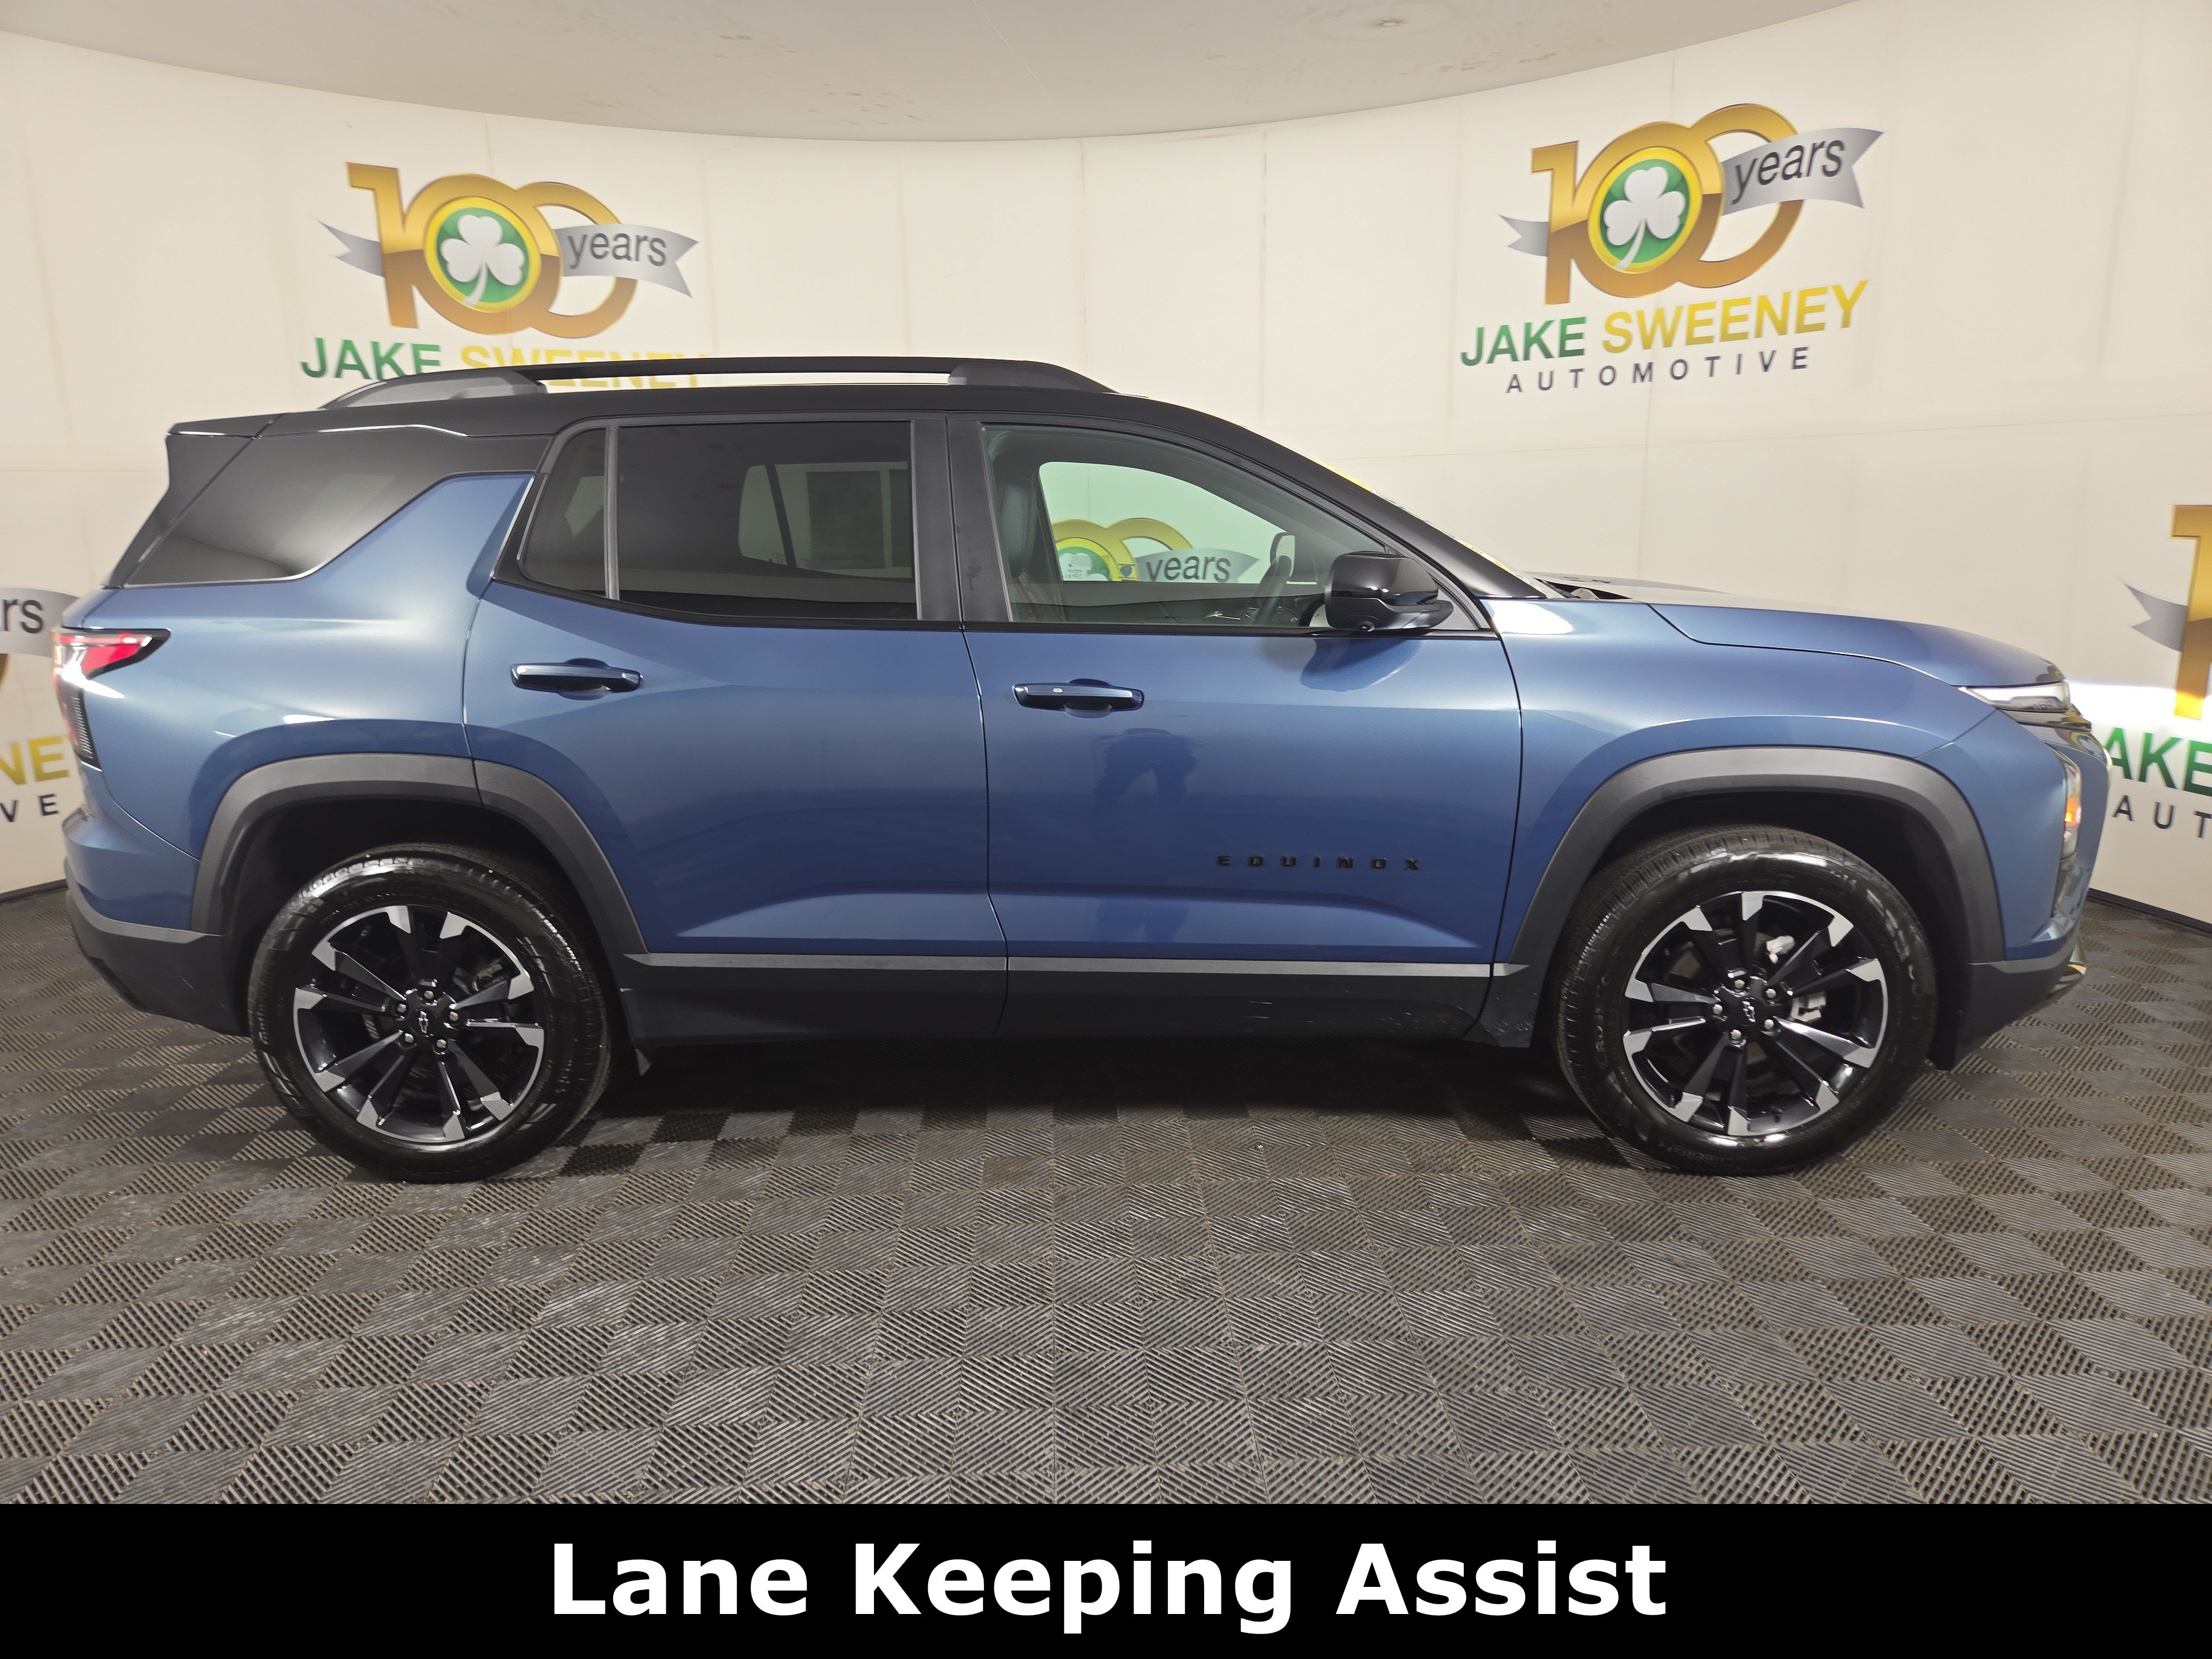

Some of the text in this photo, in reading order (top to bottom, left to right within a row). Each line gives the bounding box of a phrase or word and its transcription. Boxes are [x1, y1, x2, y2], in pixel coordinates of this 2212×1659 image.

[1531, 103, 1846, 305] 100 years
[345, 162, 668, 338] 100 years
[300, 336, 441, 381] JAKE
[1460, 279, 1870, 366] JAKE SWEENEY
[1505, 346, 1810, 394] AUTOMOTIVE
[2104, 726, 2212, 798] AKE
[1216, 854, 1421, 870] EQUINOX
